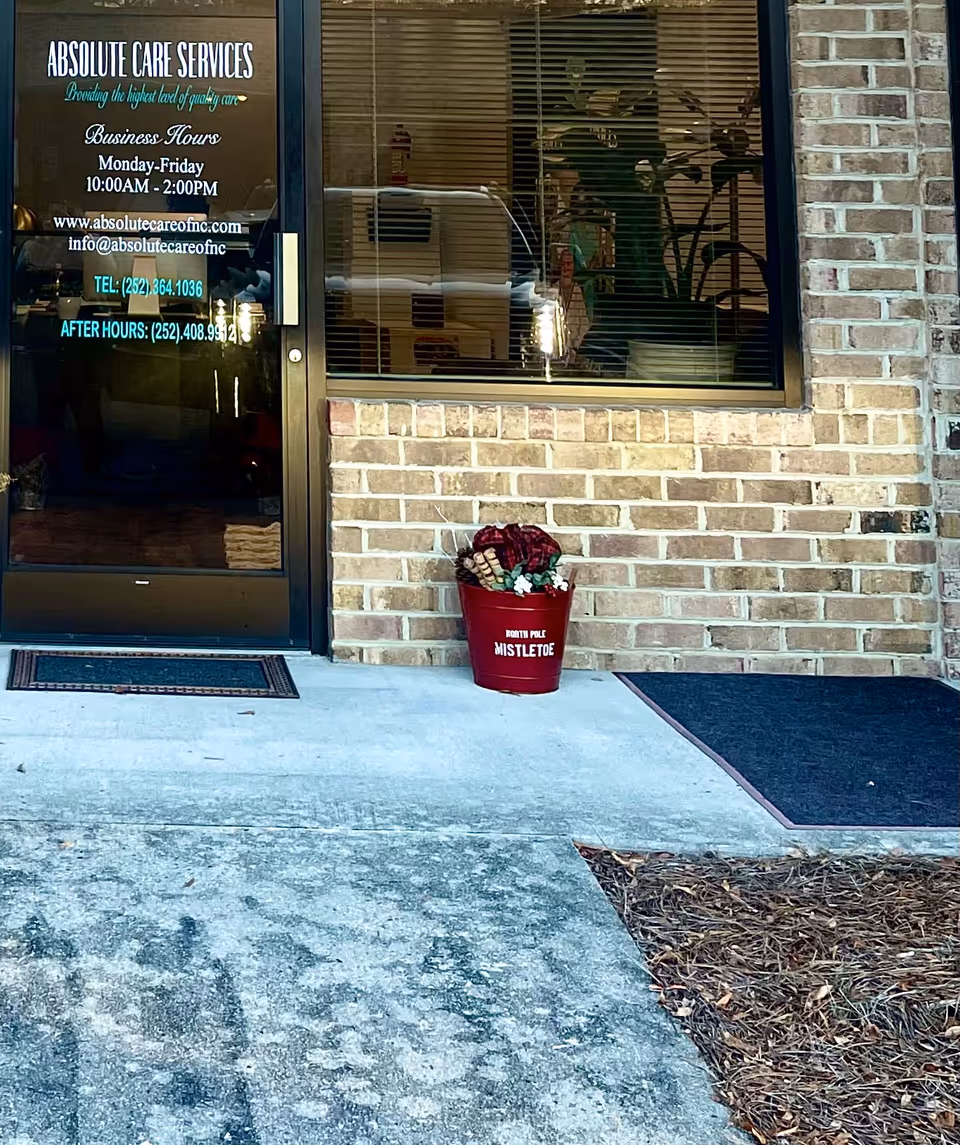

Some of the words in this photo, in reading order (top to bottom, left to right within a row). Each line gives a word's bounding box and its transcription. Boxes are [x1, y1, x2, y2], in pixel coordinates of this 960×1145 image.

[48, 41, 127, 78] ABSOLUTE
[132, 41, 173, 78] CARE
[178, 42, 253, 79] SERVICES
[65, 81, 108, 108] Providing
[111, 83, 126, 102] the
[127, 83, 156, 109] highest
[158, 84, 177, 104] level
[176, 85, 192, 110] of
[188, 86, 220, 112] quality
[221, 94, 239, 105] care
[85, 124, 163, 145] Business
[165, 124, 221, 146] Hours
[99, 156, 204, 177] Monday-Friday
[86, 177, 149, 193] 10:00AM
[163, 179, 218, 196] 2:00PM
[53, 214, 241, 234] www.absolutecareofnc.com
[69, 237, 226, 255] info@absolutecareofnc
[94, 275, 119, 294] TEL:
[121, 276, 202, 298] (252).364.1036
[61, 320, 99, 337] AFTER
[102, 321, 148, 339] HOURS:
[530, 630, 546, 638] POLE
[494, 642, 555, 657] MISTLETOE
